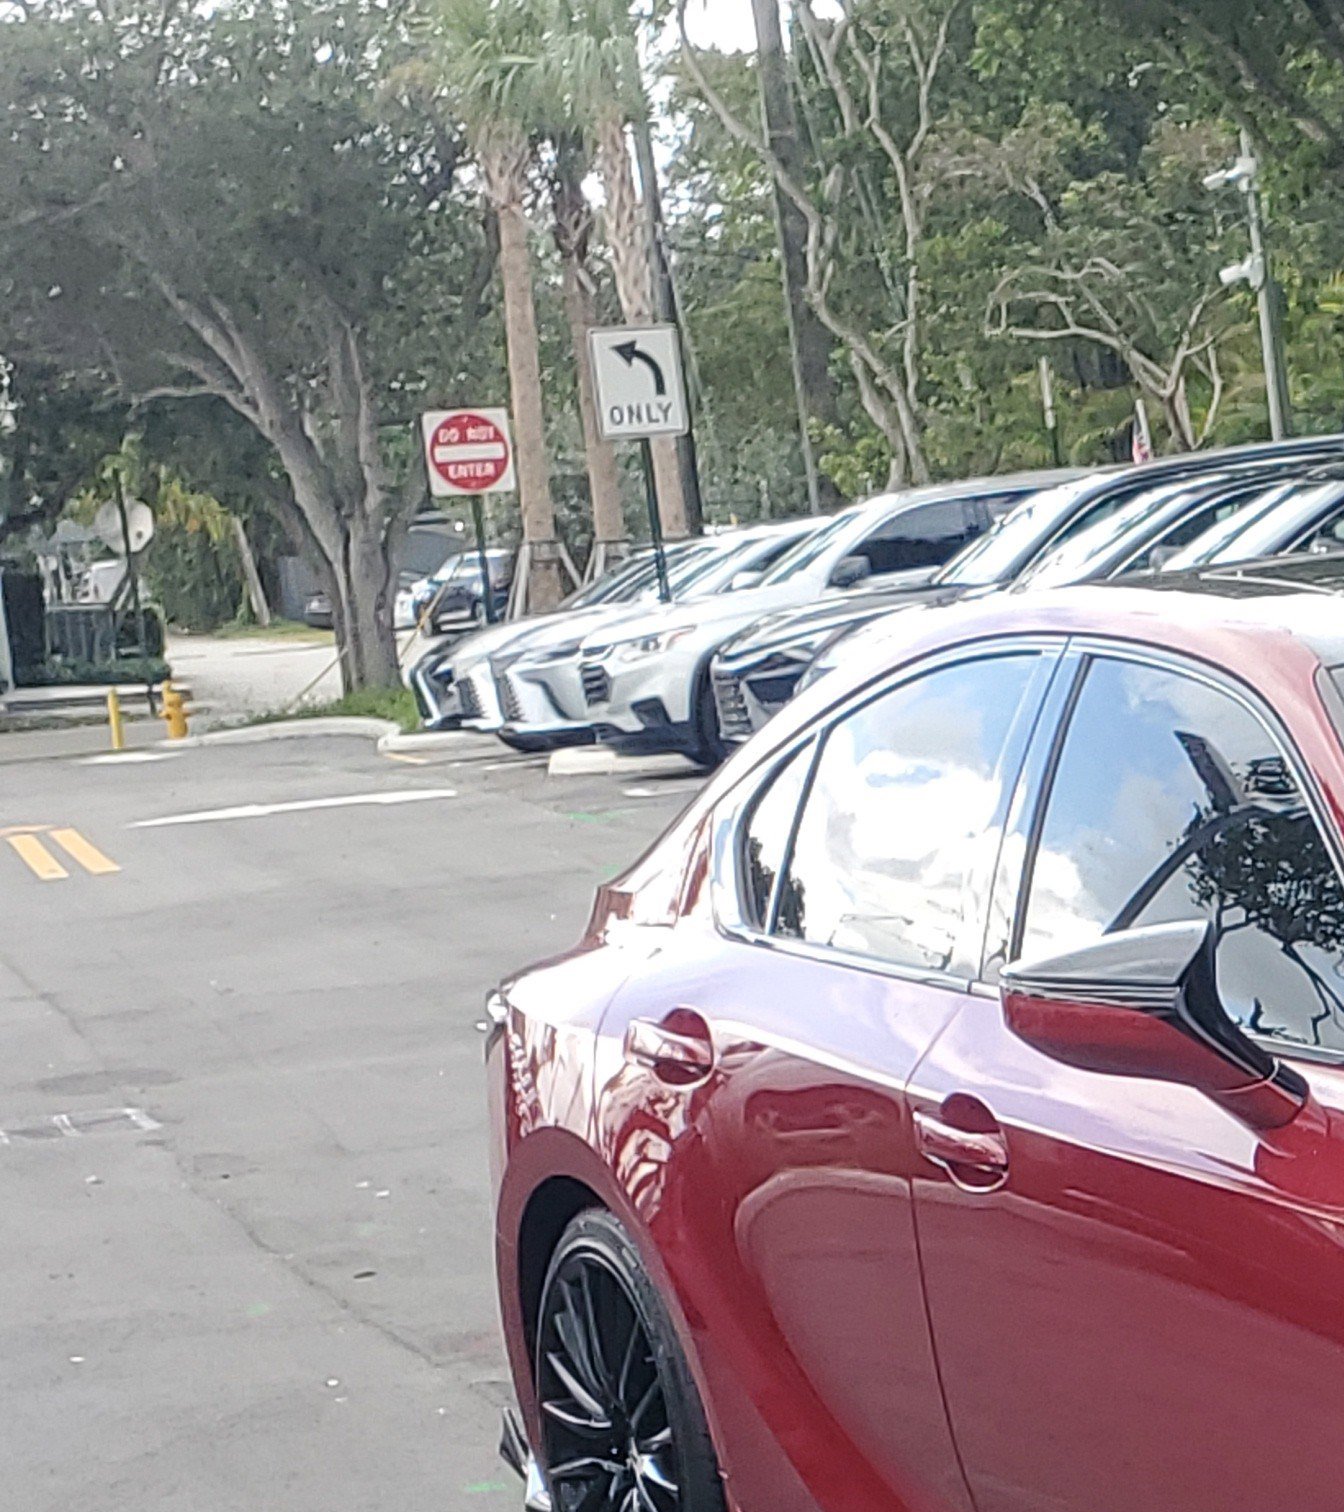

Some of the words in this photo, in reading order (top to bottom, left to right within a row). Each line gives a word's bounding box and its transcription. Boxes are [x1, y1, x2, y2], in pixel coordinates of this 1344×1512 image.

[609, 401, 672, 425] ONLY
[438, 427, 460, 443] DO
[467, 425, 496, 441] NOT
[447, 461, 496, 480] ENTER
